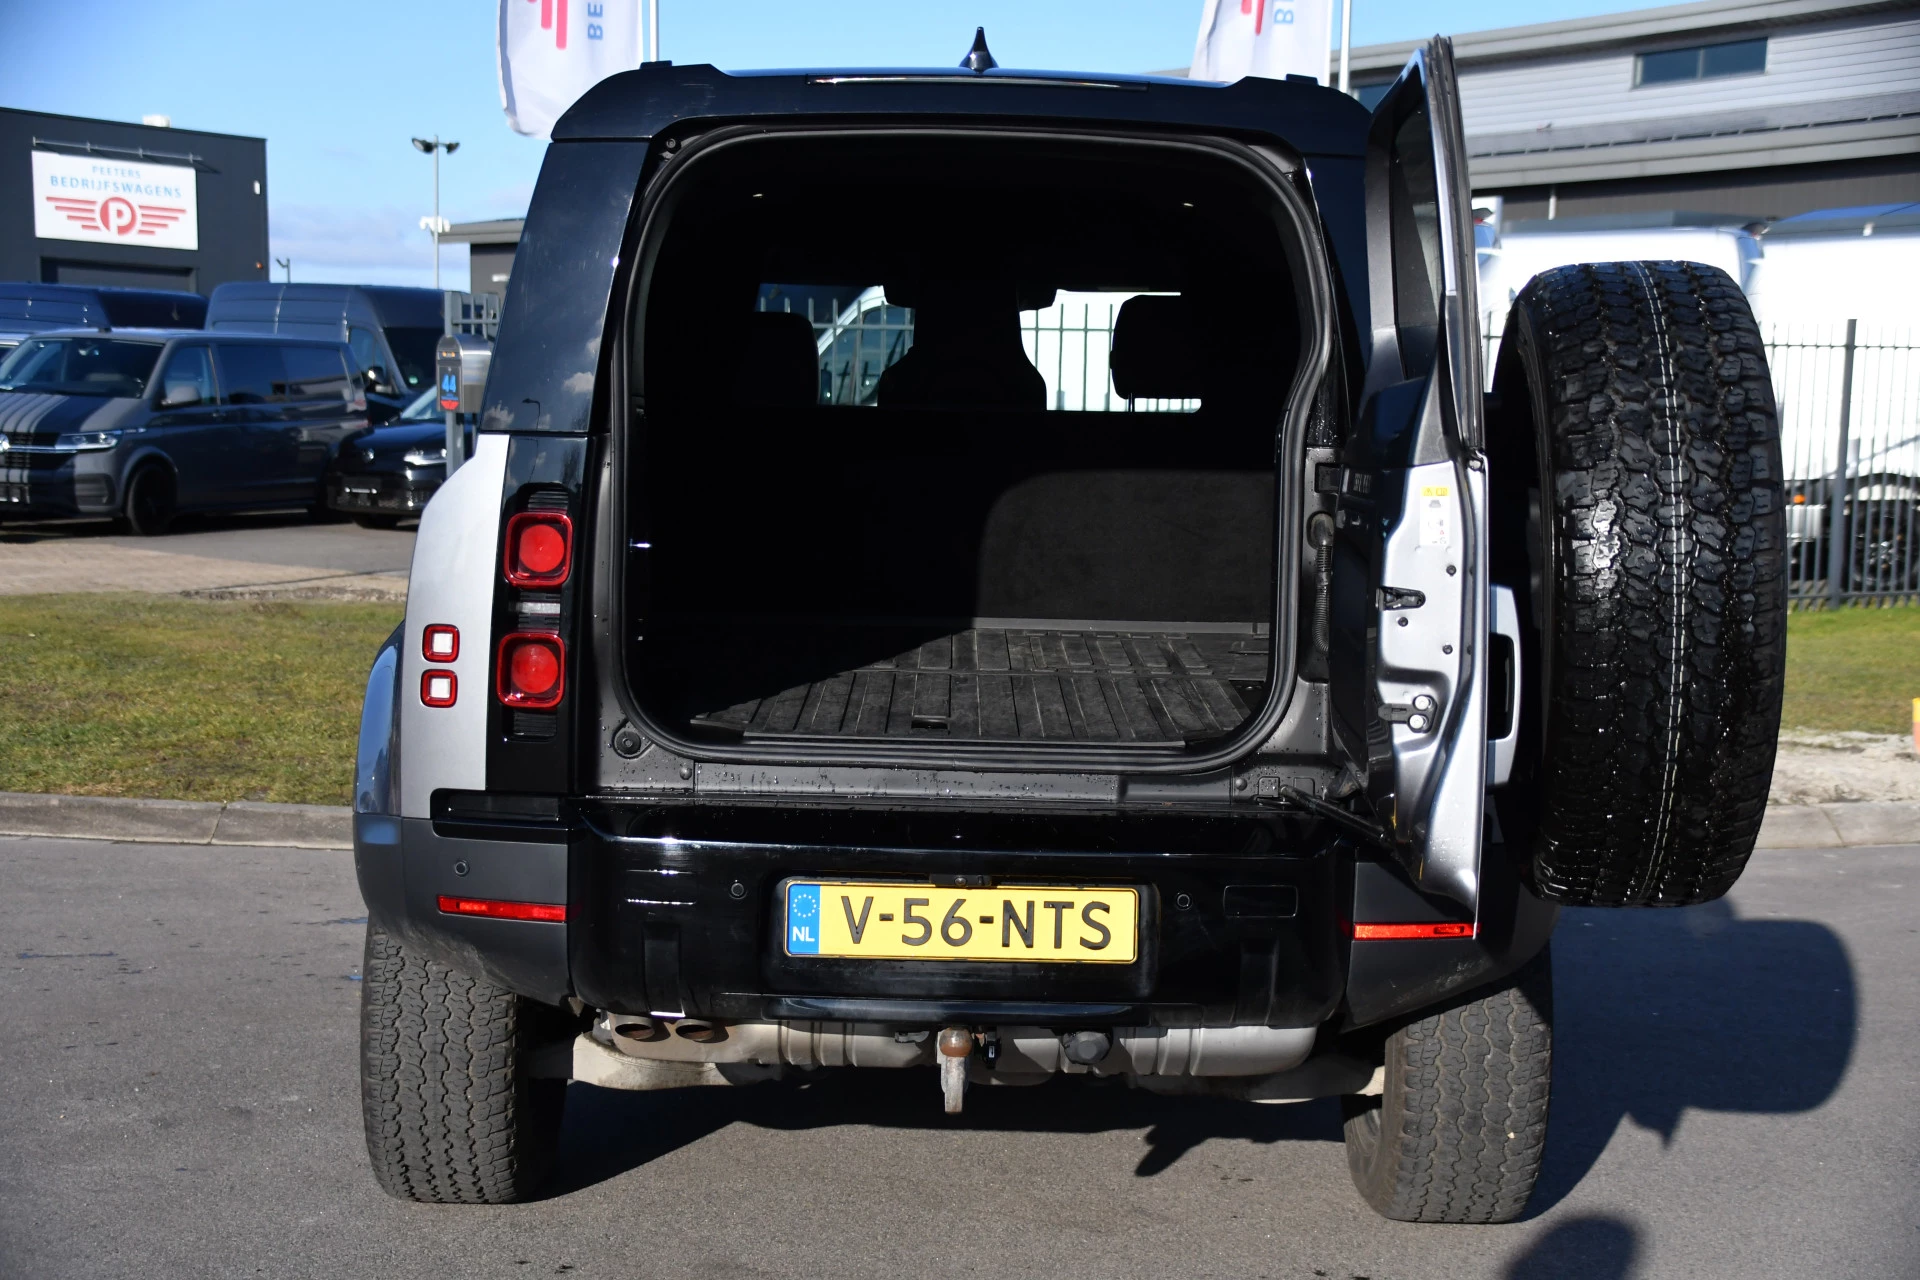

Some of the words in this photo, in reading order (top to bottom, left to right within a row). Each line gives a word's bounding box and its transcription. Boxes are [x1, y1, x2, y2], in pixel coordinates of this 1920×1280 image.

[1273, 0, 1294, 24] B
[92, 165, 141, 179] PEETERS
[50, 175, 182, 198] BEDRIJFSWAGENS
[441, 374, 457, 393] 44
[840, 895, 1112, 951] V-56-NTS
[792, 926, 815, 942] NL
